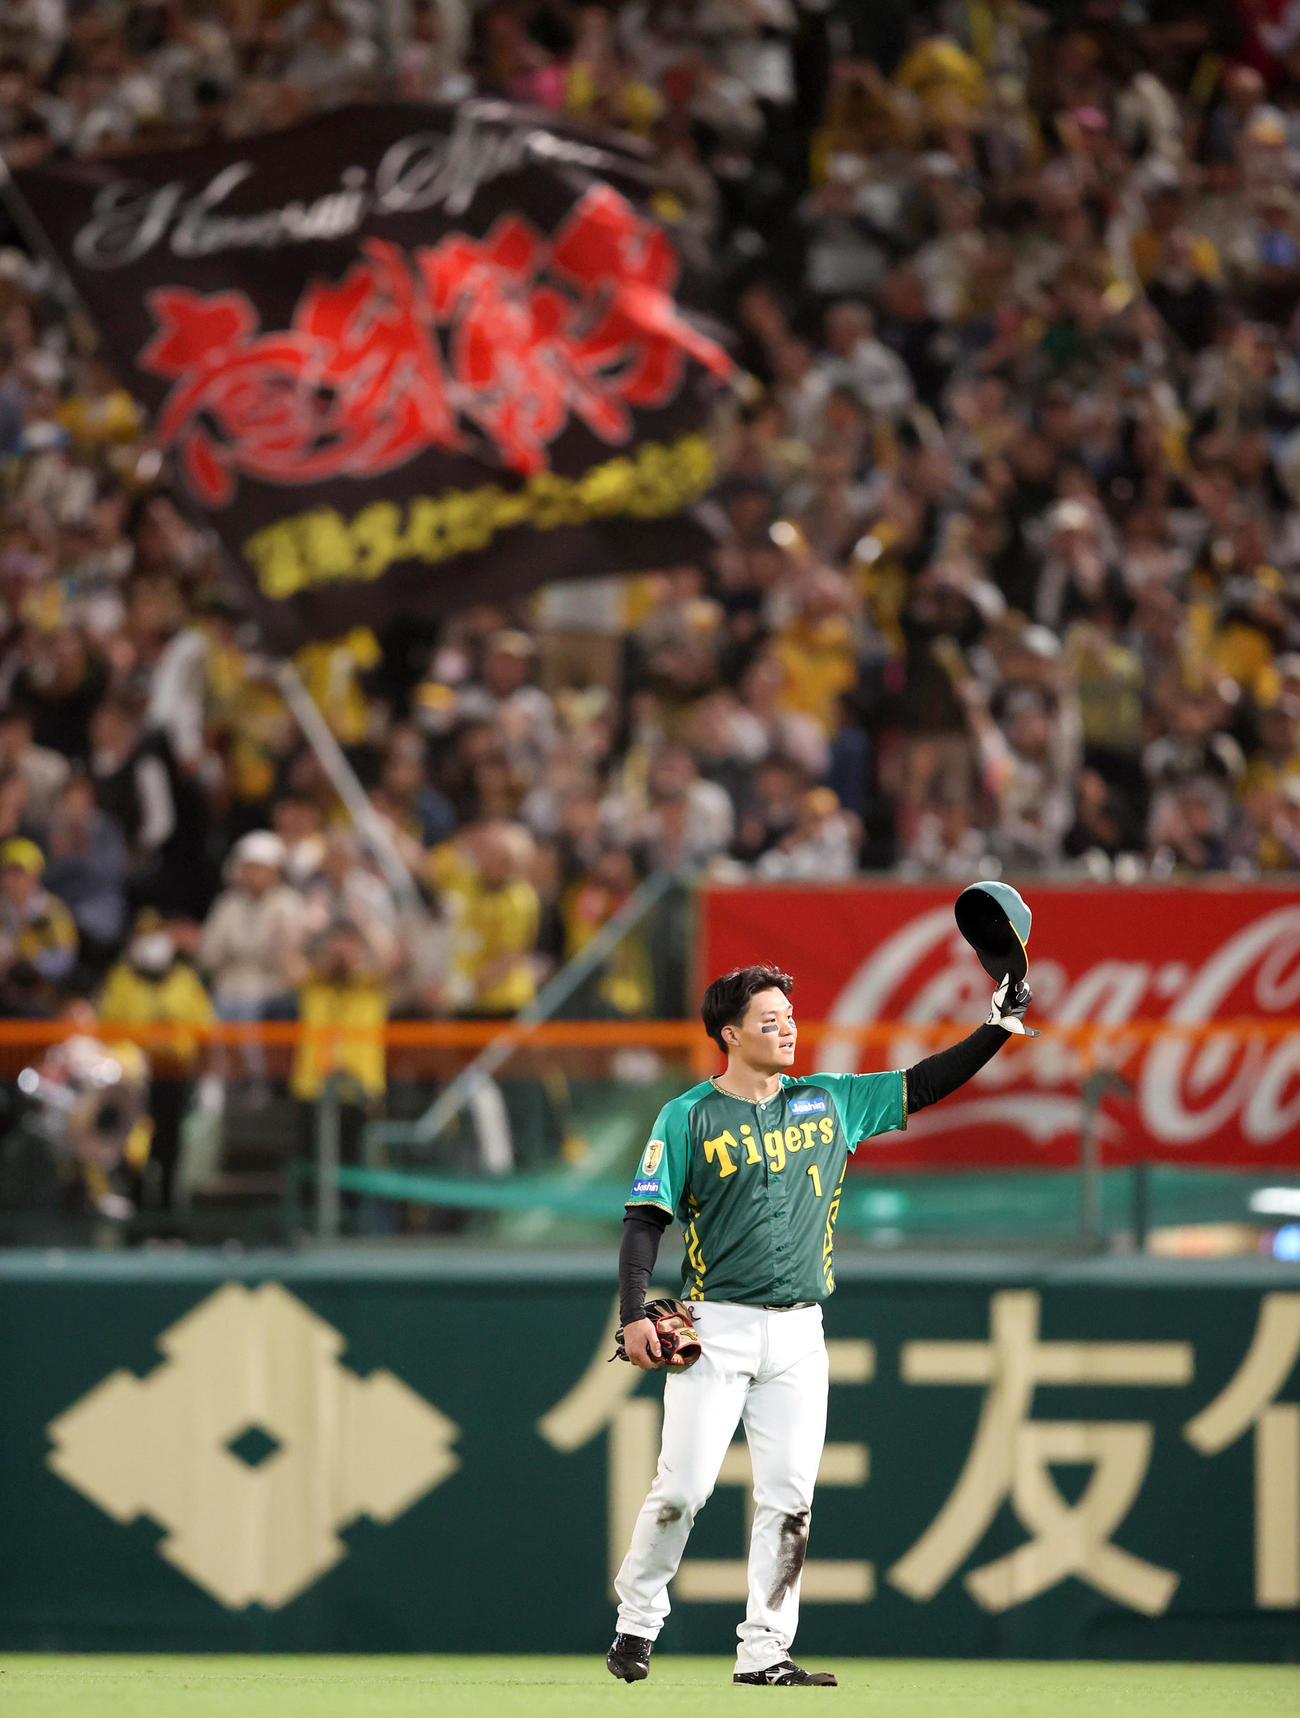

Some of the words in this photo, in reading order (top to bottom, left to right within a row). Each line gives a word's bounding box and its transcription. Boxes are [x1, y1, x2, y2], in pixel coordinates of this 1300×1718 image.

[791, 1100, 825, 1113] Joshin
[703, 1117, 835, 1178] Tigers
[633, 1181, 659, 1192] Joshin
[806, 1164, 823, 1197] 1
